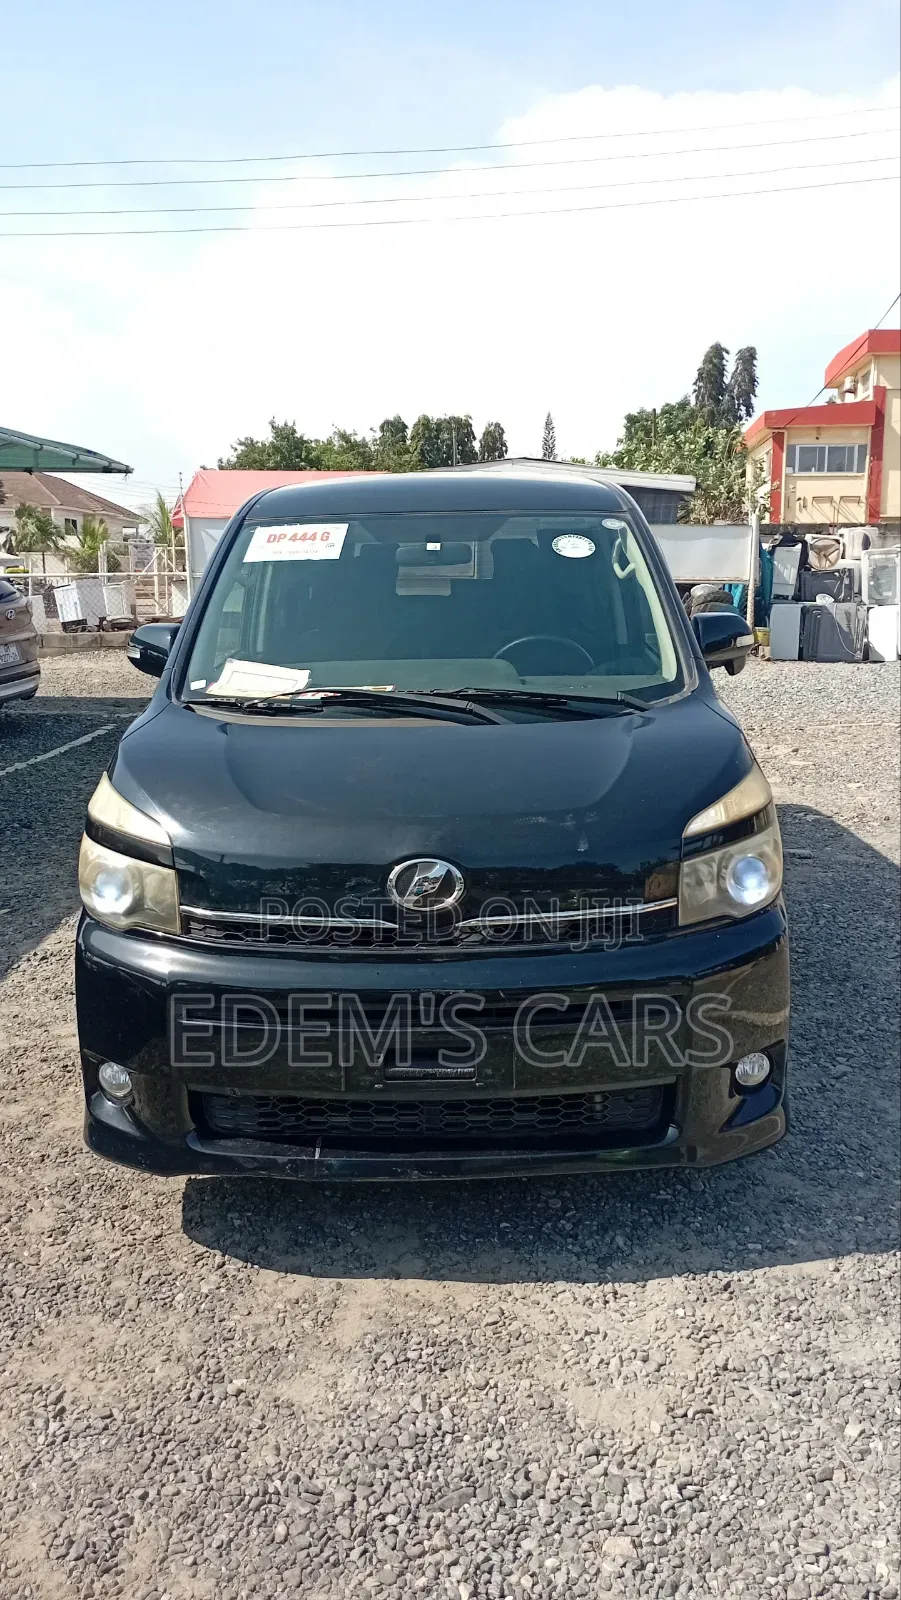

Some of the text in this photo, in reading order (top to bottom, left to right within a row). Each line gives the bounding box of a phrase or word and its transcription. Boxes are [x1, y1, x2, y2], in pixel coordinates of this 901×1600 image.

[266, 531, 330, 543] DP 444 G
